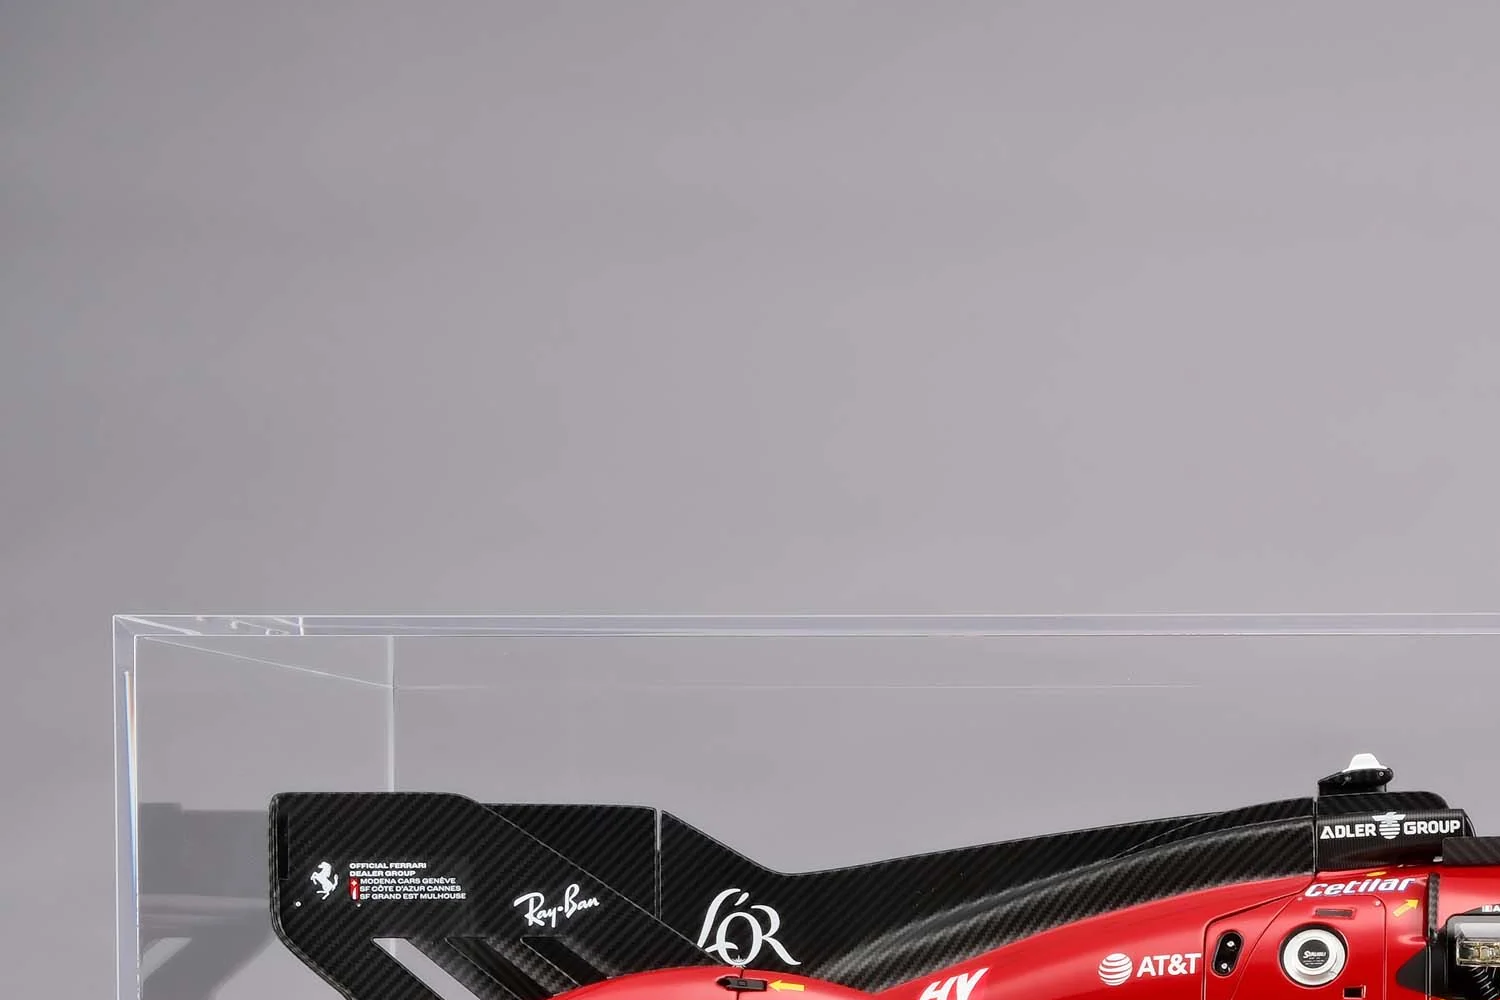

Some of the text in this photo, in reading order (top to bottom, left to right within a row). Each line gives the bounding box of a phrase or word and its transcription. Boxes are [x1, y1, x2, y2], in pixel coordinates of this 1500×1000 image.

[1319, 819, 1461, 840] ADLER GROUP
[1304, 877, 1416, 898] Cetilar
[1136, 953, 1202, 978] AT&T
